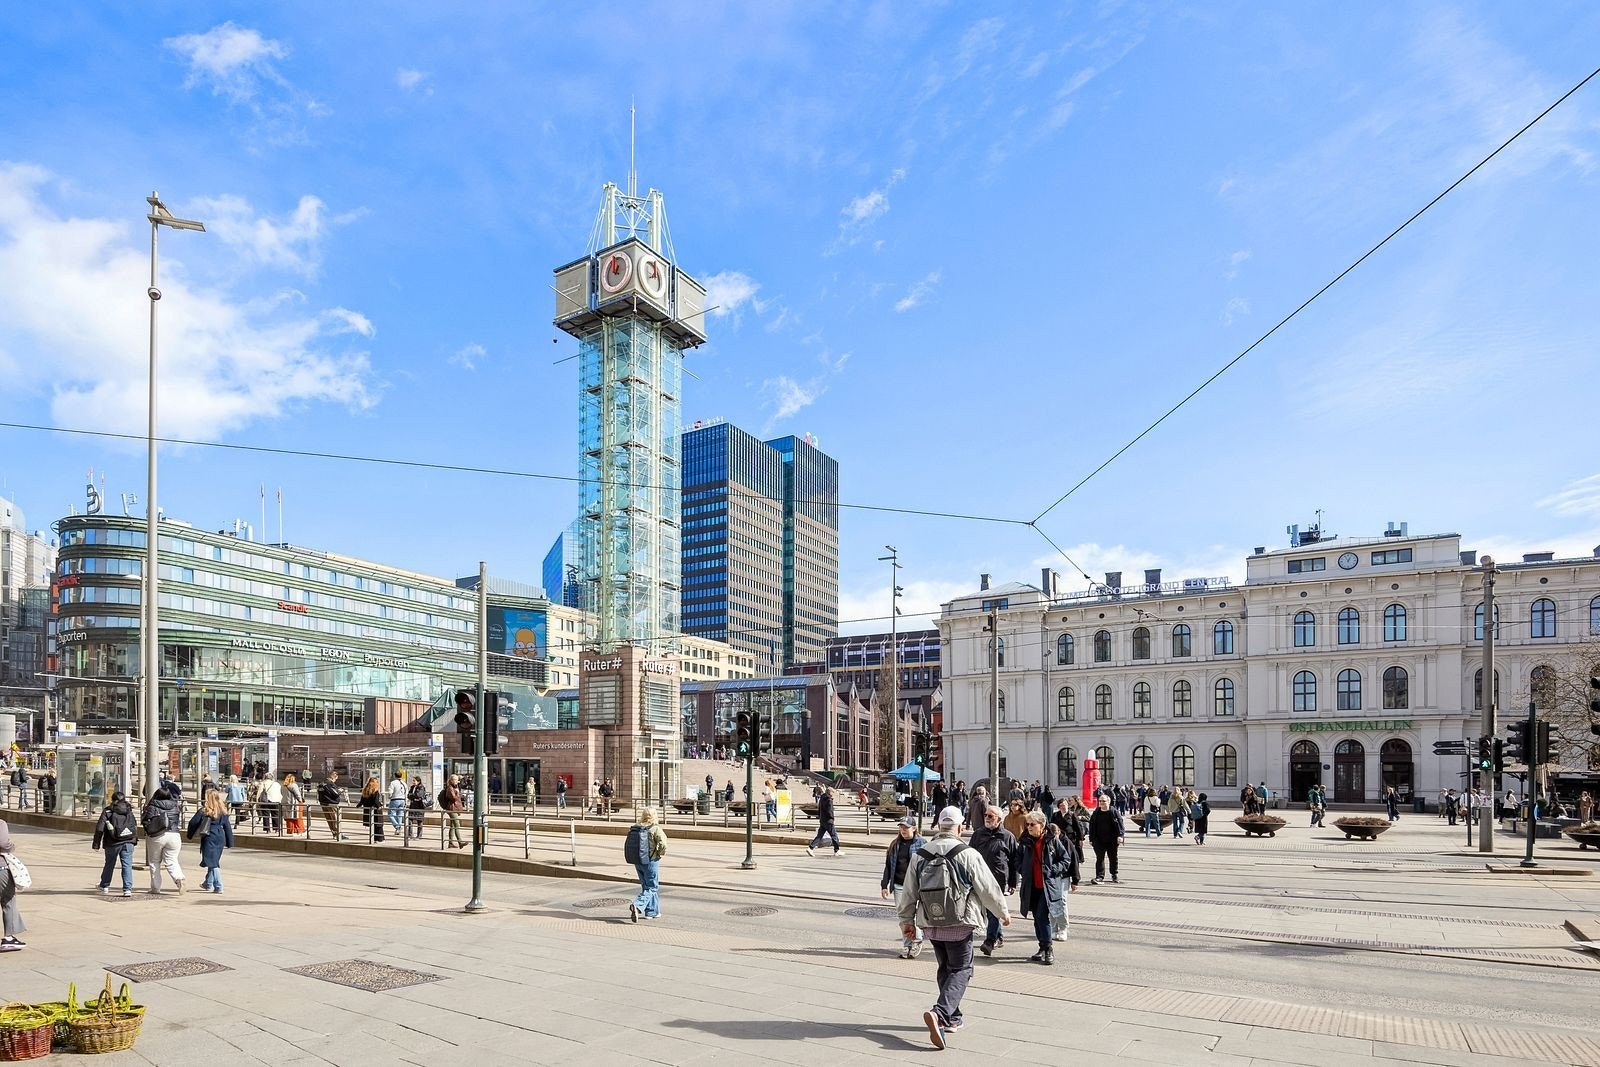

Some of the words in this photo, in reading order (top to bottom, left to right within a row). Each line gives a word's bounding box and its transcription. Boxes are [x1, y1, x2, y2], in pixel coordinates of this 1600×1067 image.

[1142, 582, 1180, 592] GRAND
[1184, 576, 1232, 587] CENTRAL
[232, 639, 262, 649] MALL
[263, 643, 278, 651] OF
[321, 648, 350, 659] EGON
[584, 657, 622, 671] Ruter#
[643, 659, 677, 674] Ruter#
[1289, 720, 1414, 732] ØSTBANEHALLEN
